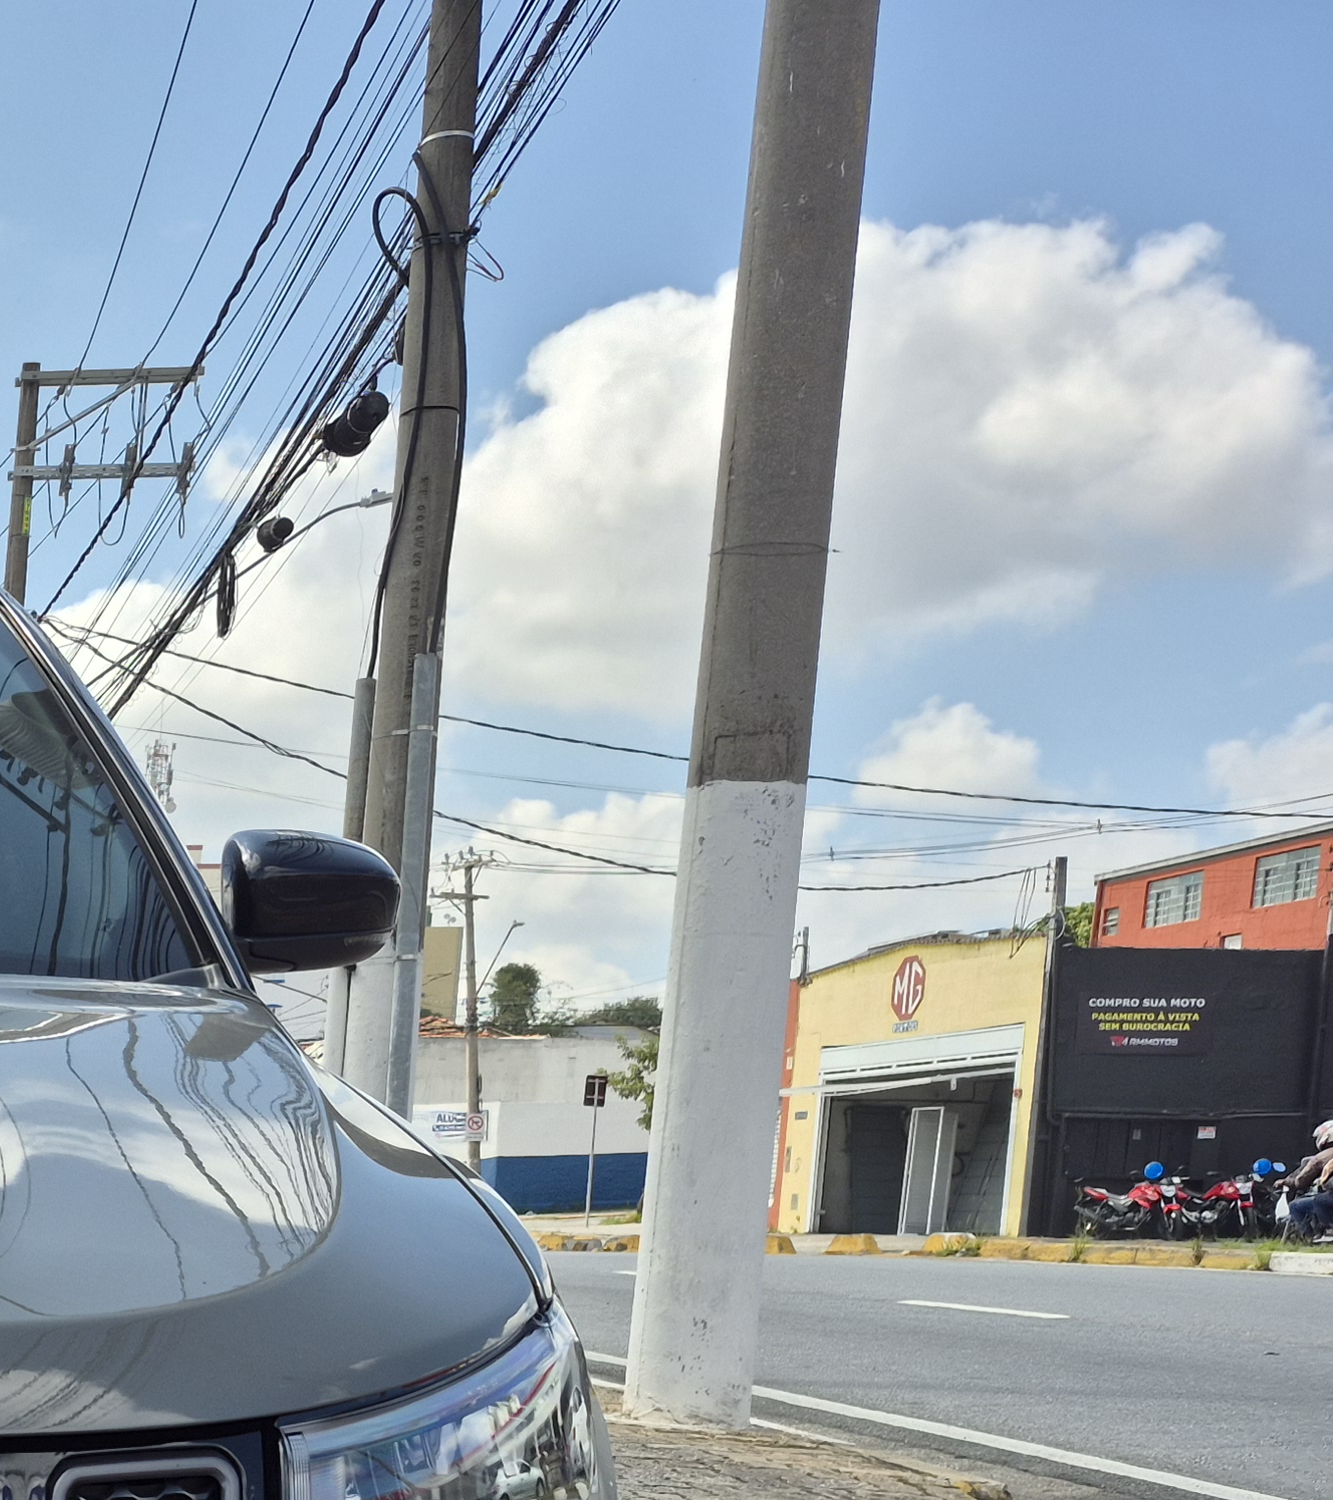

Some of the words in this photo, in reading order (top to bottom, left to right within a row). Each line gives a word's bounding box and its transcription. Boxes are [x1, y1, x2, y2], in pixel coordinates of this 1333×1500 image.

[894, 960, 924, 1015] MG
[1088, 997, 1140, 1008] COMPRO
[1142, 997, 1167, 1008] SUA
[1170, 998, 1206, 1008] MOTO
[1092, 1012, 1155, 1021] PAGAMENTO
[1168, 1012, 1200, 1021] VISTA
[1098, 1022, 1120, 1031] SEM
[1122, 1022, 1191, 1031] BUROCRACIA
